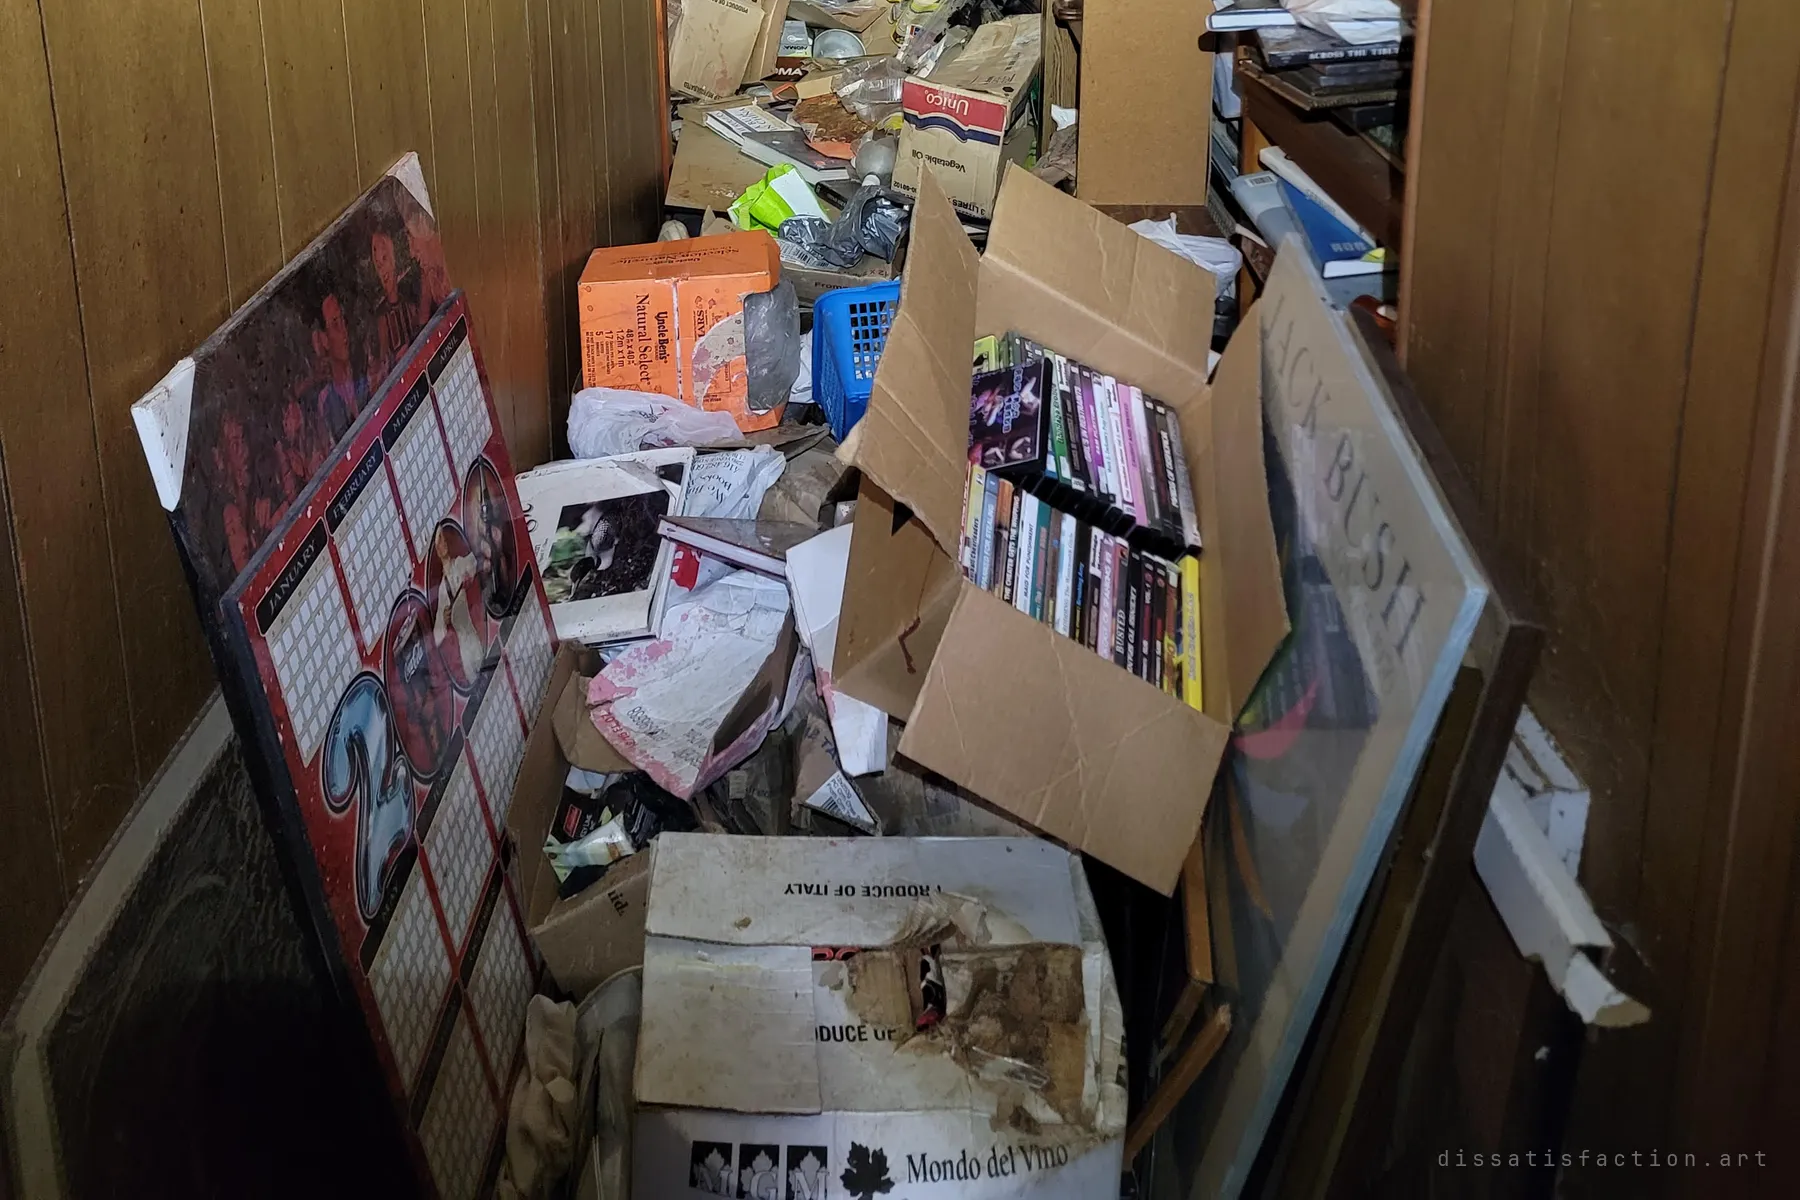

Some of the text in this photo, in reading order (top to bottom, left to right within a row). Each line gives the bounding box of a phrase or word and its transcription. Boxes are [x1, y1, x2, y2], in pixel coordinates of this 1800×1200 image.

[726, 1, 749, 14] PRODUCT
[1308, 50, 1344, 60] ACROSS
[1347, 48, 1367, 58] THE
[926, 93, 969, 116] Unico
[912, 149, 966, 173] Vegetable Oil
[952, 199, 980, 214] LITRES
[604, 331, 613, 340] 17
[616, 329, 625, 350] 1.2m
[626, 329, 634, 339] 48
[635, 293, 651, 383] Natural Select
[655, 312, 669, 360] Uncle Ben's
[618, 355, 625, 368] 1m
[627, 349, 635, 360] 40
[391, 389, 421, 433] MARCH
[333, 451, 378, 520] FEBRUARY
[1325, 430, 1427, 653] BUSH
[268, 540, 317, 614] JANUARY
[1005, 558, 1013, 586] CHEATER
[1115, 608, 1126, 654] BUSTED
[784, 883, 828, 896] ITALY
[834, 885, 856, 897] OF
[906, 1143, 1069, 1184] Mondo del Vino
